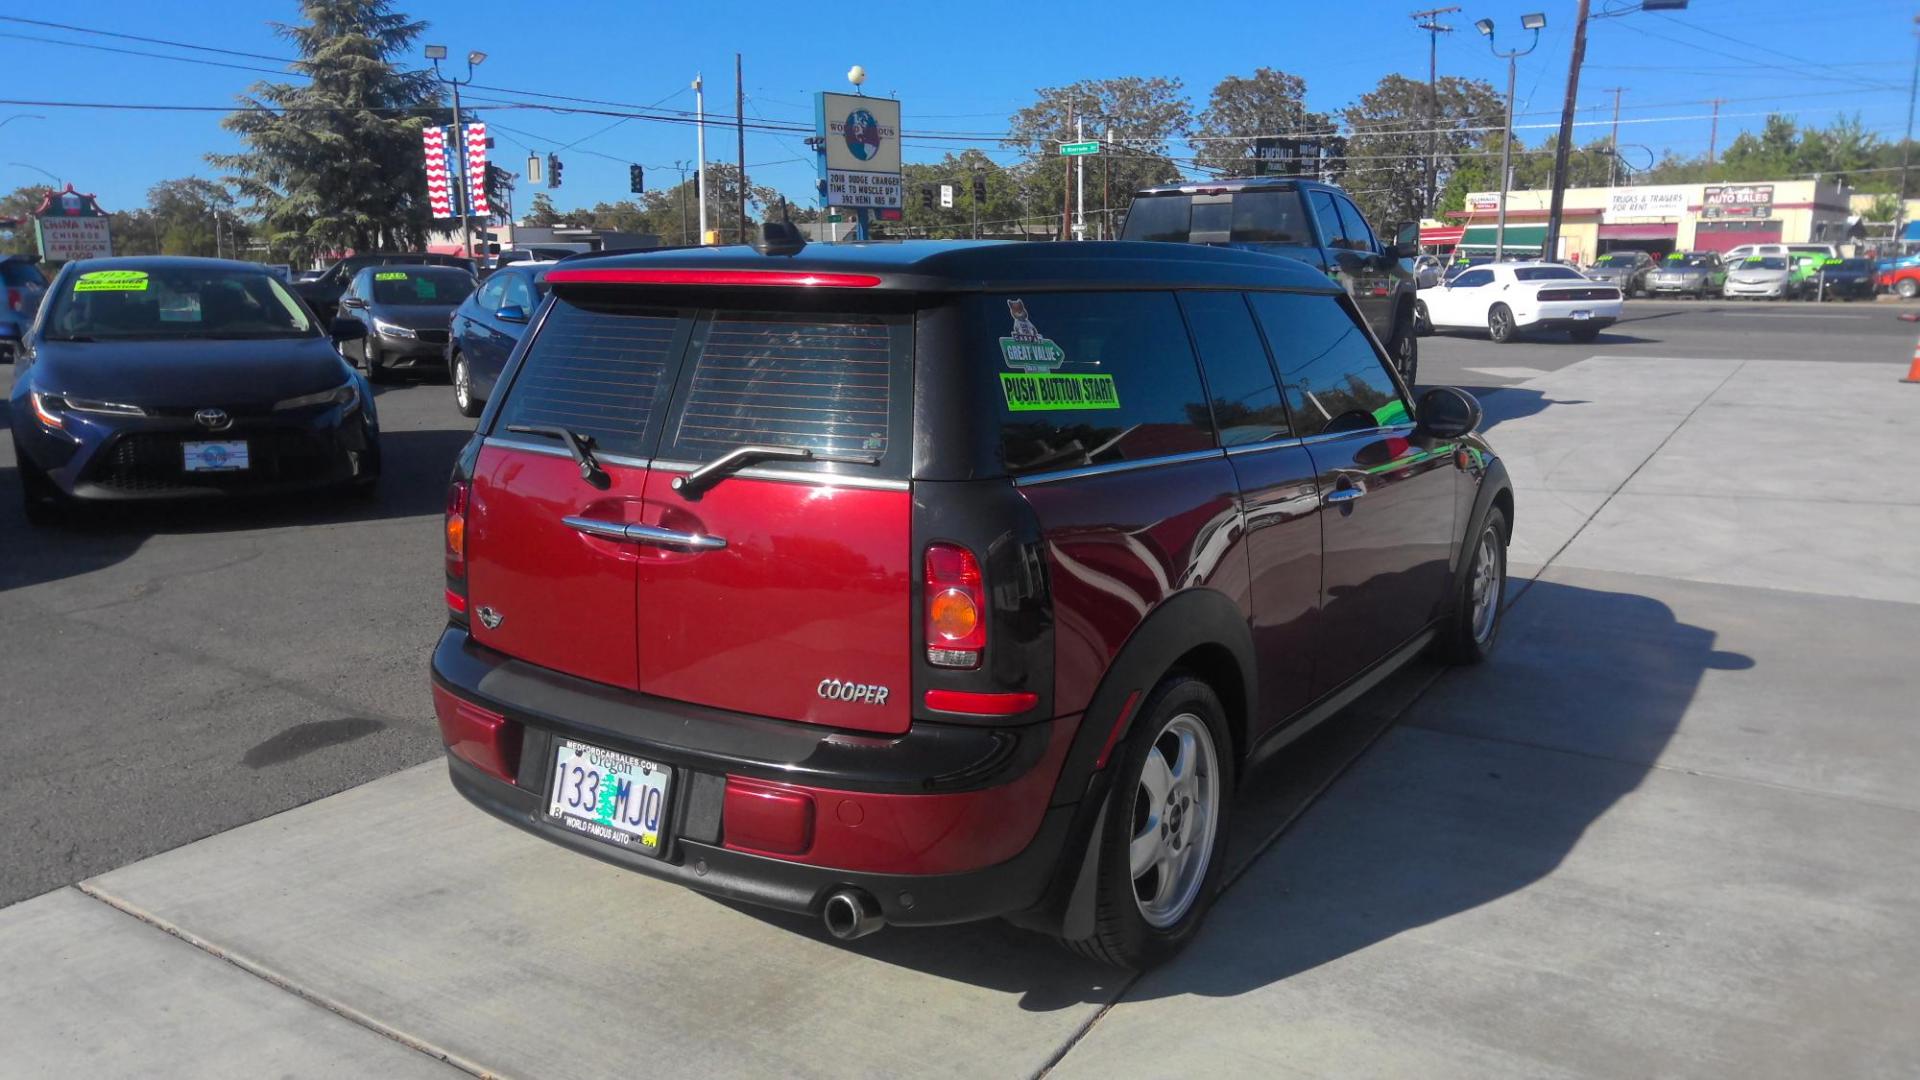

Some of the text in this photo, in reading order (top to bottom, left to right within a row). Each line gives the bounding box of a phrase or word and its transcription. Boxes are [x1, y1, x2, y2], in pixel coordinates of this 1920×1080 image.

[1260, 147, 1293, 162] EMERALD
[848, 175, 868, 184] DODGE
[830, 183, 845, 193] TIME
[848, 185, 857, 194] TO
[858, 185, 883, 195] MUSCLE
[842, 195, 853, 204] 392
[855, 195, 871, 205] HEMI
[1613, 195, 1638, 203] TRUCKS
[1650, 194, 1683, 202] TRAILERS
[1708, 193, 1769, 204] AUTO SALES
[1613, 203, 1626, 211] FOR
[1629, 203, 1648, 211] RENT
[44, 219, 80, 230] CHINA
[52, 231, 100, 239] CHINESE
[51, 244, 106, 252] AMERICAN
[1007, 345, 1057, 361] GREAT VALUE
[1004, 377, 1114, 402] PUSH BUTTON START
[817, 678, 889, 705] COOPER
[566, 740, 658, 771] MEDFORDCARSALES.COM
[590, 754, 632, 775] Oregon
[557, 762, 661, 831] 133 MJQ
[566, 817, 629, 844] WORLD FAMOUS AUTO
